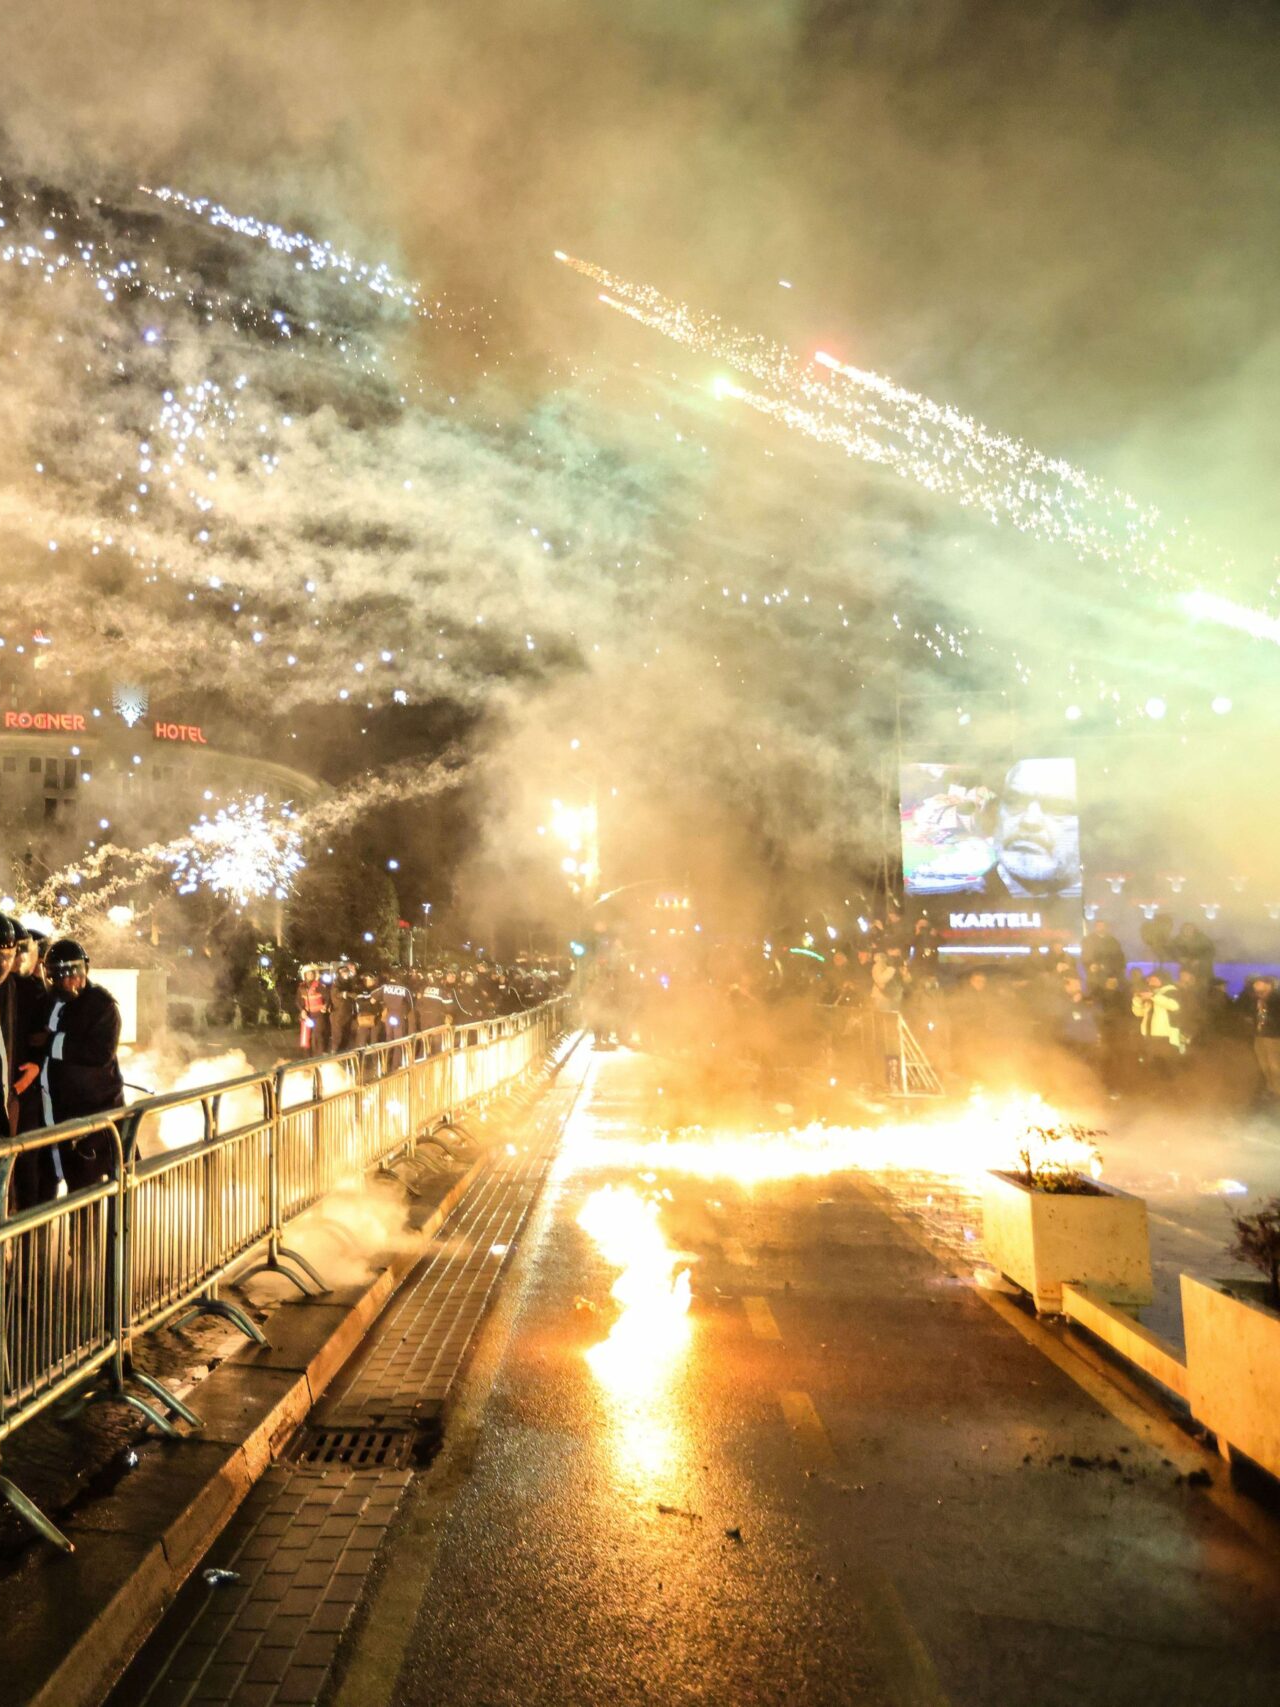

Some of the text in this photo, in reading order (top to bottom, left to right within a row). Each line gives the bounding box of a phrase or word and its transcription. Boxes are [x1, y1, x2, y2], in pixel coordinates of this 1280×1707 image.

[5, 712, 206, 743] ROGNER HOTEL
[949, 912, 1041, 928] KARTELI
